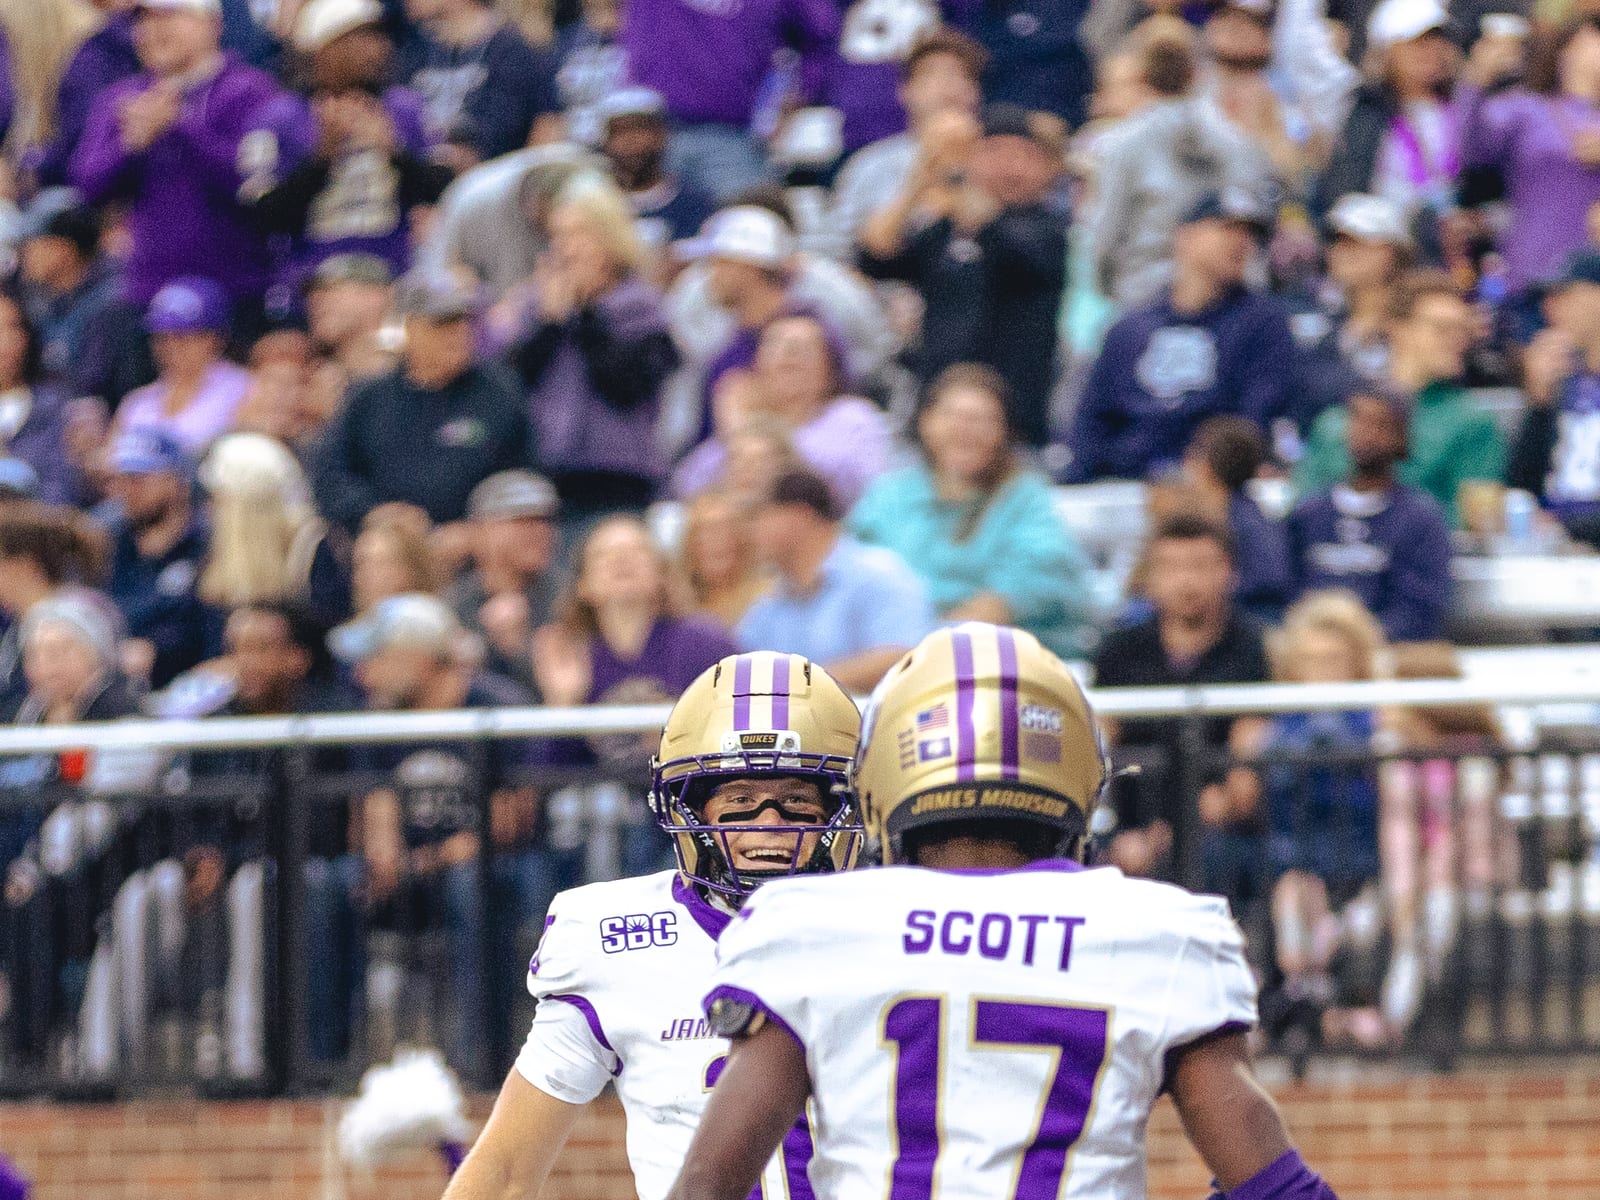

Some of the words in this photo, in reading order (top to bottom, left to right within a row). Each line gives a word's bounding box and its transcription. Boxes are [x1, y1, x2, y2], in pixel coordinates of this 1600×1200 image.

[742, 735, 776, 745] DUKES
[911, 789, 976, 815] JAMES
[980, 789, 1068, 818] MADISON
[600, 911, 678, 954] SBC
[902, 909, 1086, 973] SCOTT
[660, 1017, 719, 1041] JAM
